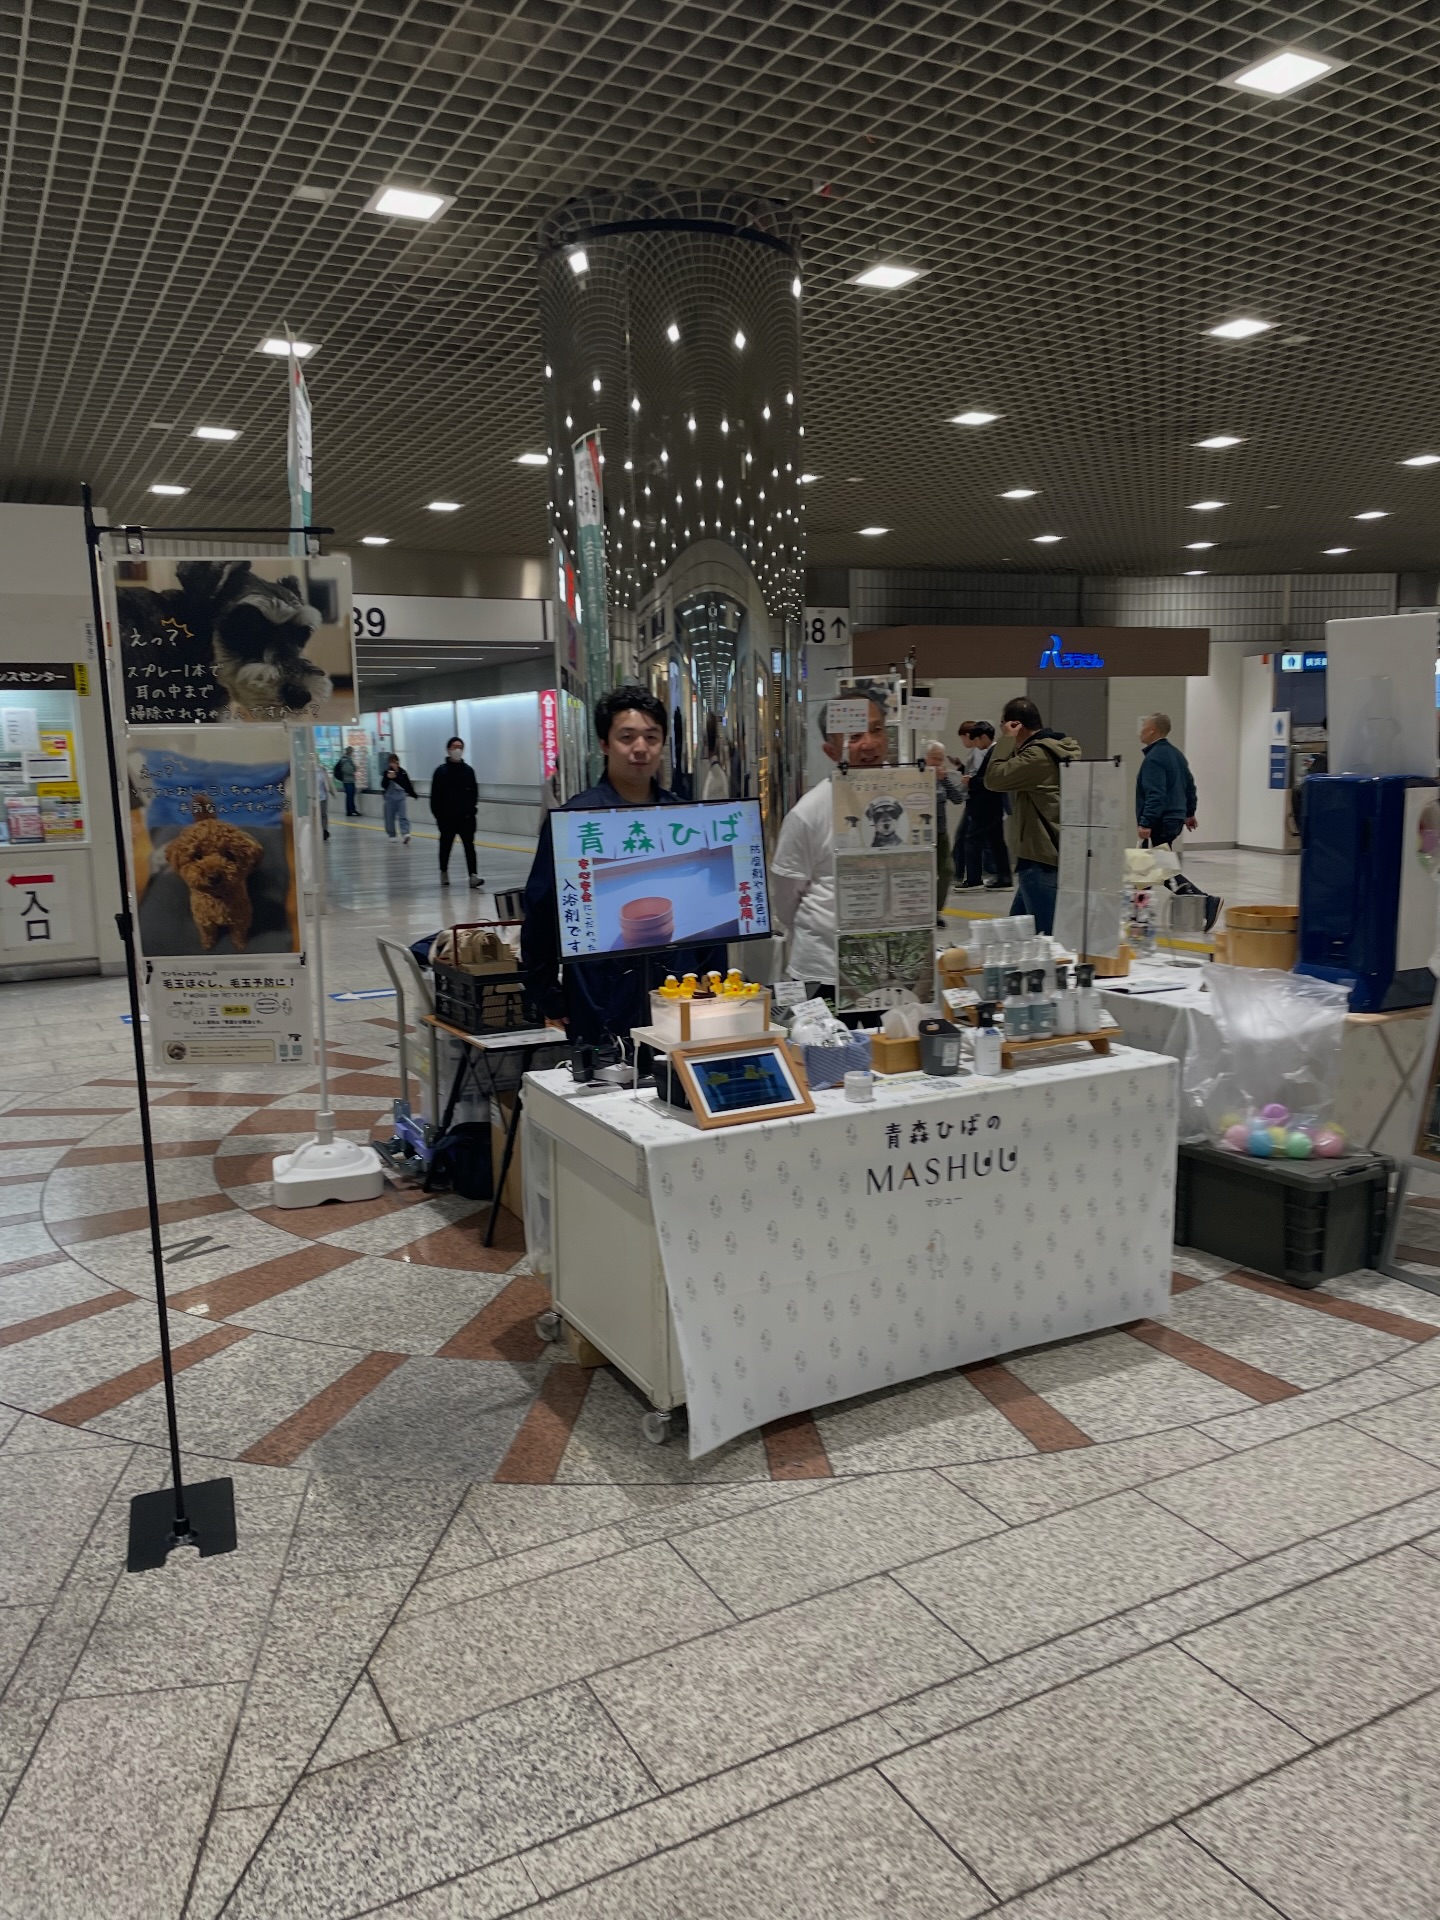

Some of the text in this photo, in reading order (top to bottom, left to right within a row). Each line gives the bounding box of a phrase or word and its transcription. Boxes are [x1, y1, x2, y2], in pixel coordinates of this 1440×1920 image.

[805, 617, 825, 644] 8
[135, 684, 215, 701] 耳の中まで
[577, 810, 743, 856] 青森ひば
[20, 890, 51, 941] 入口
[562, 878, 582, 953] 入浴剤です
[885, 1113, 1002, 1149] 青森ひばの
[866, 1144, 1018, 1196] MASHUU
